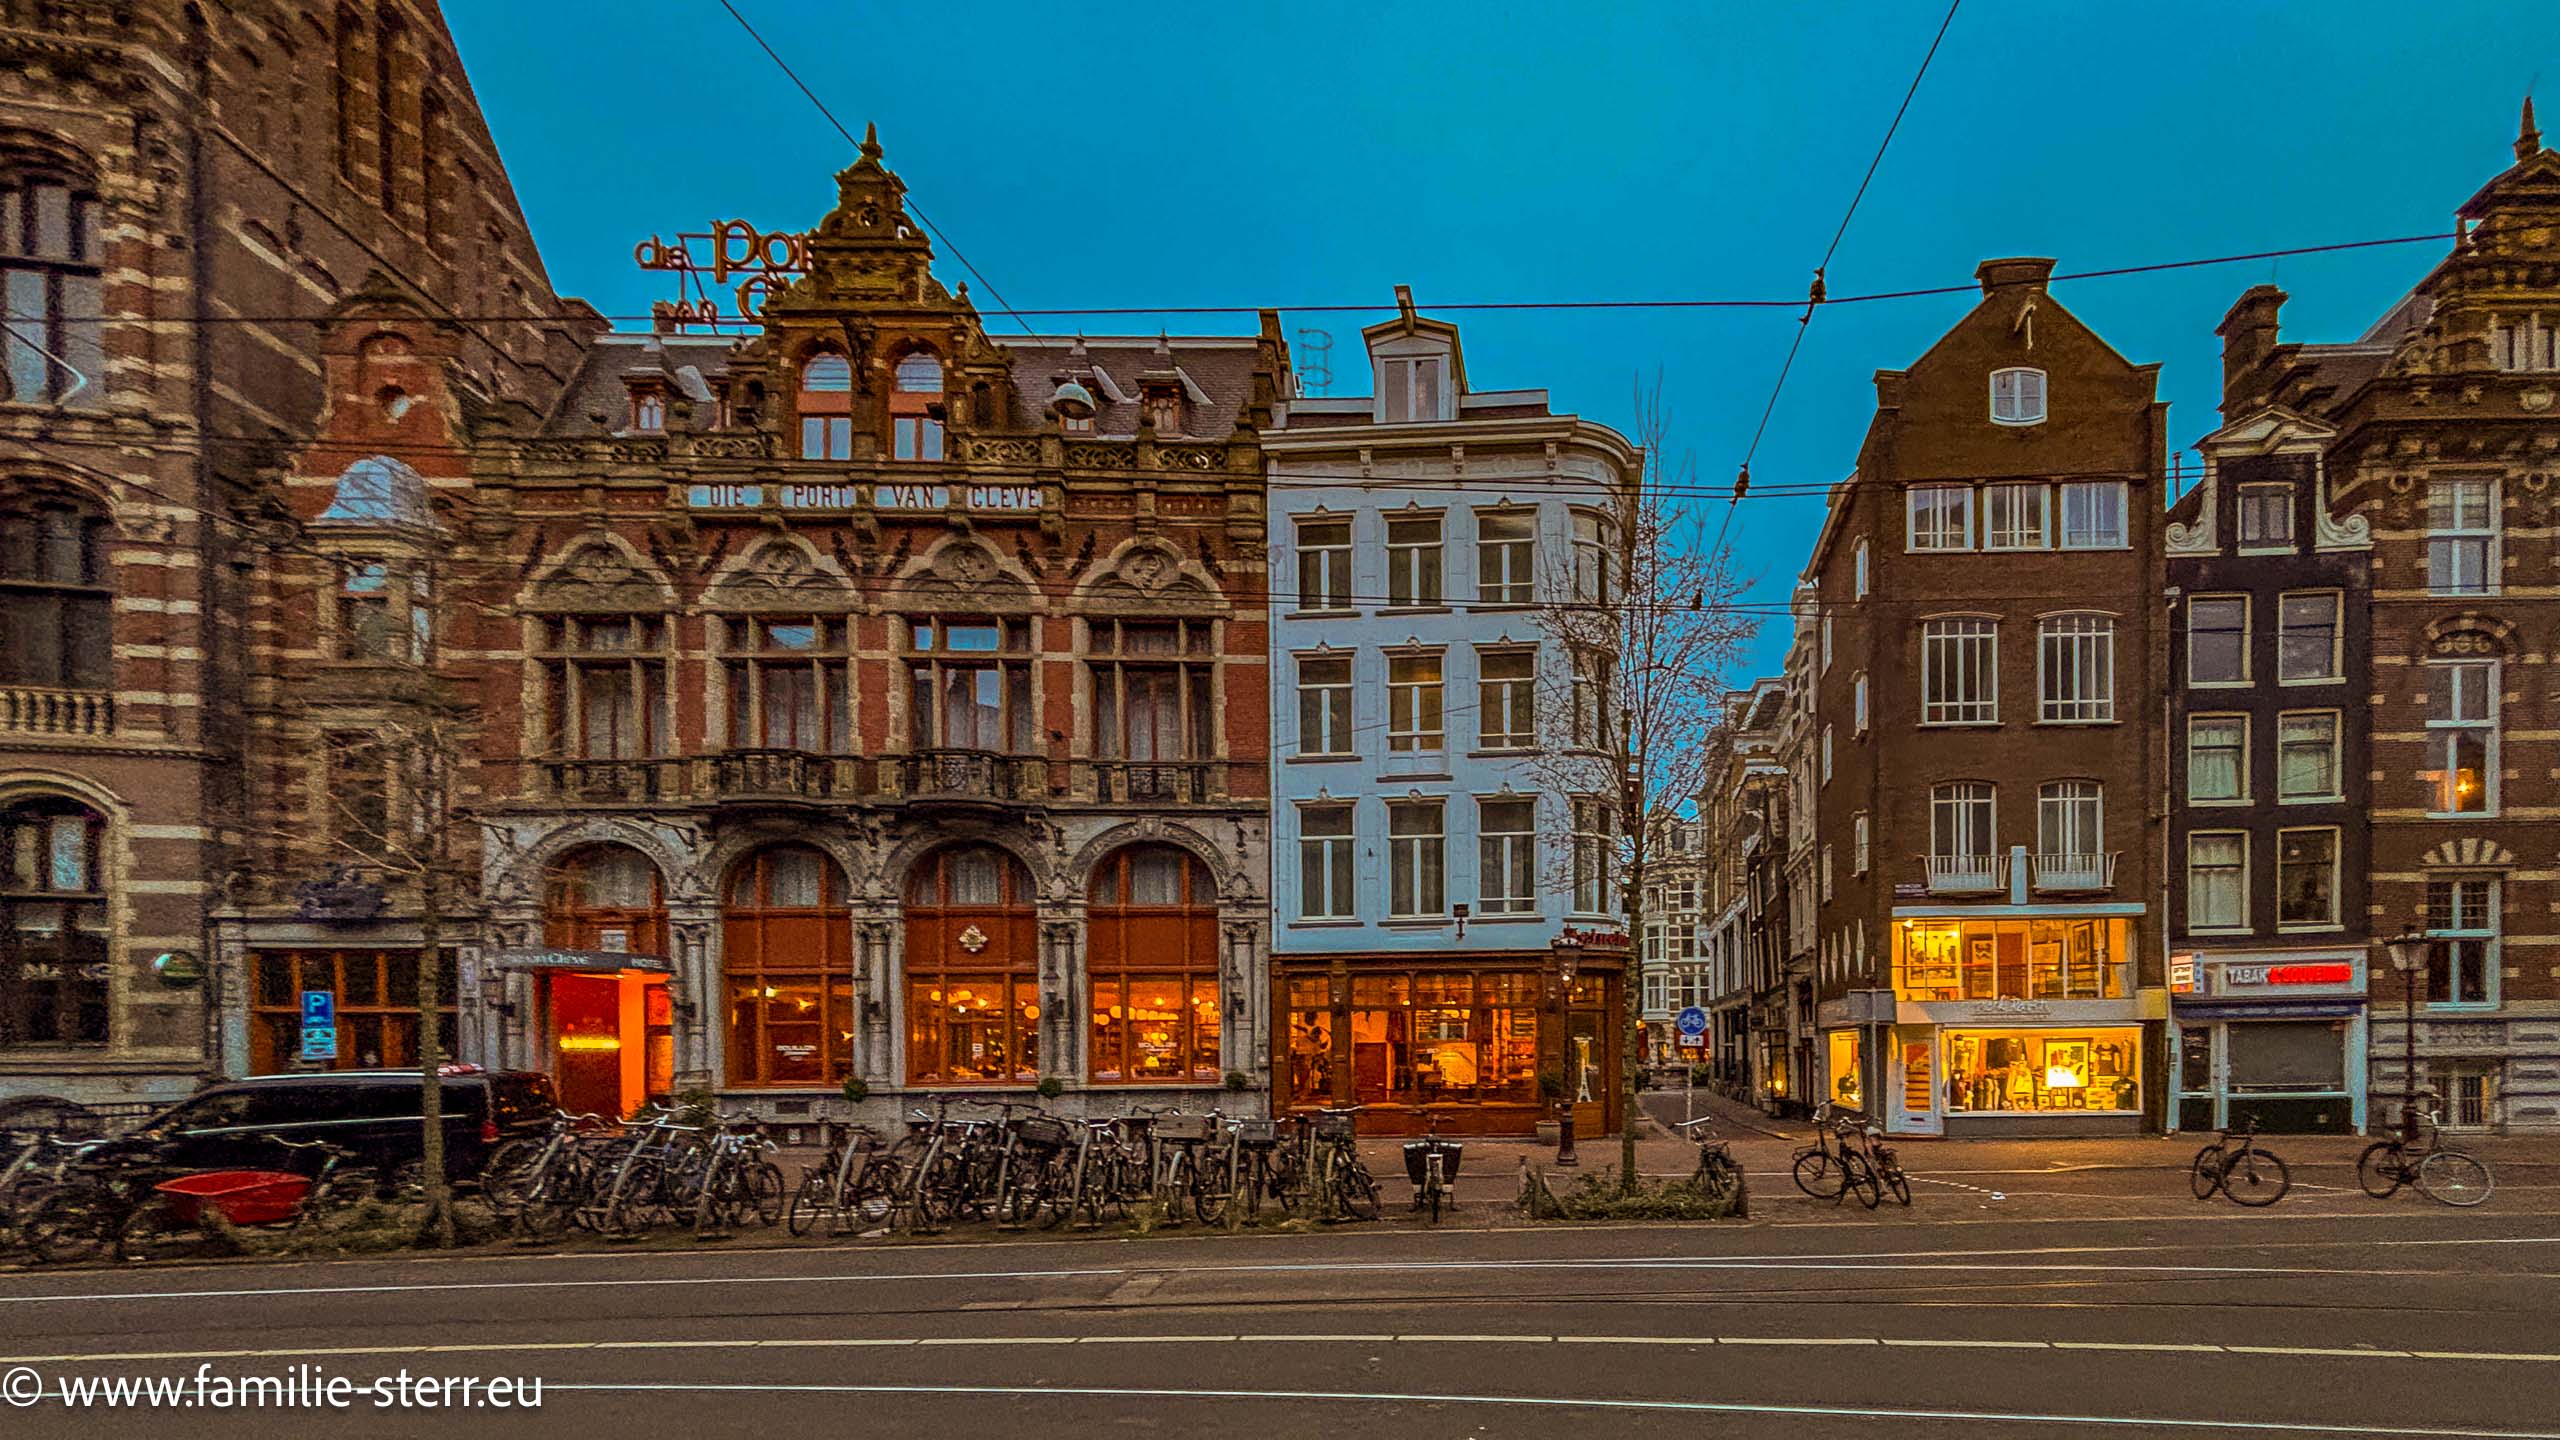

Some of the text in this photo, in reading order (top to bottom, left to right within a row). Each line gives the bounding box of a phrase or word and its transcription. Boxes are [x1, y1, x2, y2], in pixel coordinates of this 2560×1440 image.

[634, 219, 813, 283] die Por
[710, 485, 1039, 508] DIE PORT VAN CLEVE
[1563, 926, 1631, 946] Heinek
[2226, 967, 2268, 985] TABAK
[309, 994, 326, 1013] P
